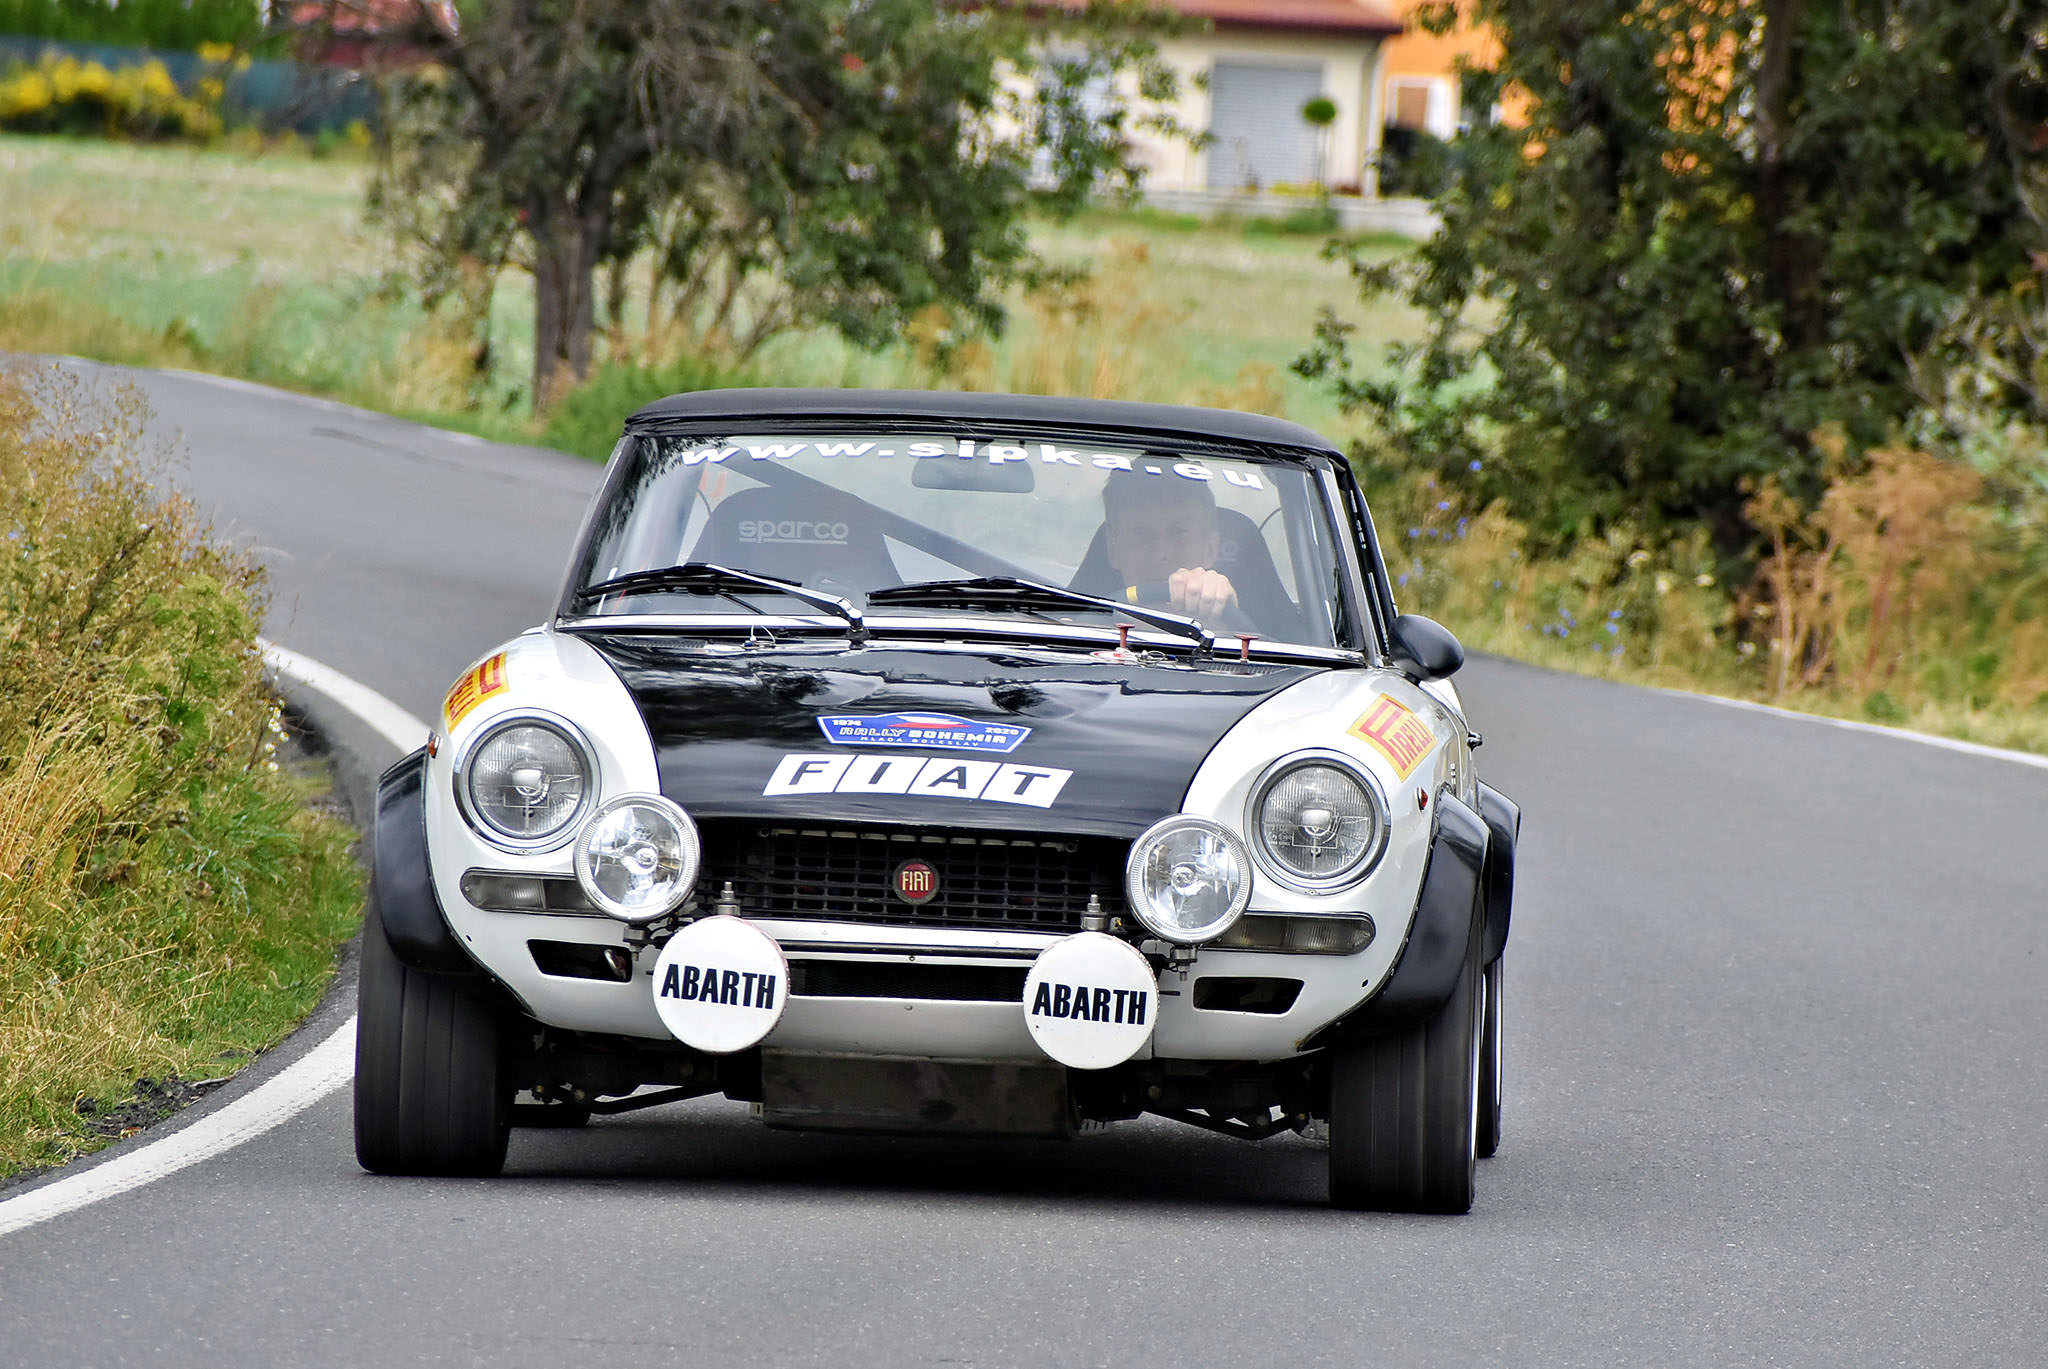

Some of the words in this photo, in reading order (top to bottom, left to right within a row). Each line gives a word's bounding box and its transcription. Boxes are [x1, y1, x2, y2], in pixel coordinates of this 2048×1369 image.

[681, 440, 1264, 490] www.sipka.eu
[738, 519, 849, 545] sparco
[840, 726, 907, 737] RALLY
[908, 729, 1007, 744] BOHEMIA
[788, 760, 1051, 796] FIAT
[902, 870, 931, 892] FIAT
[660, 963, 777, 1011] ABARTH
[1031, 981, 1148, 1026] ABARTH
